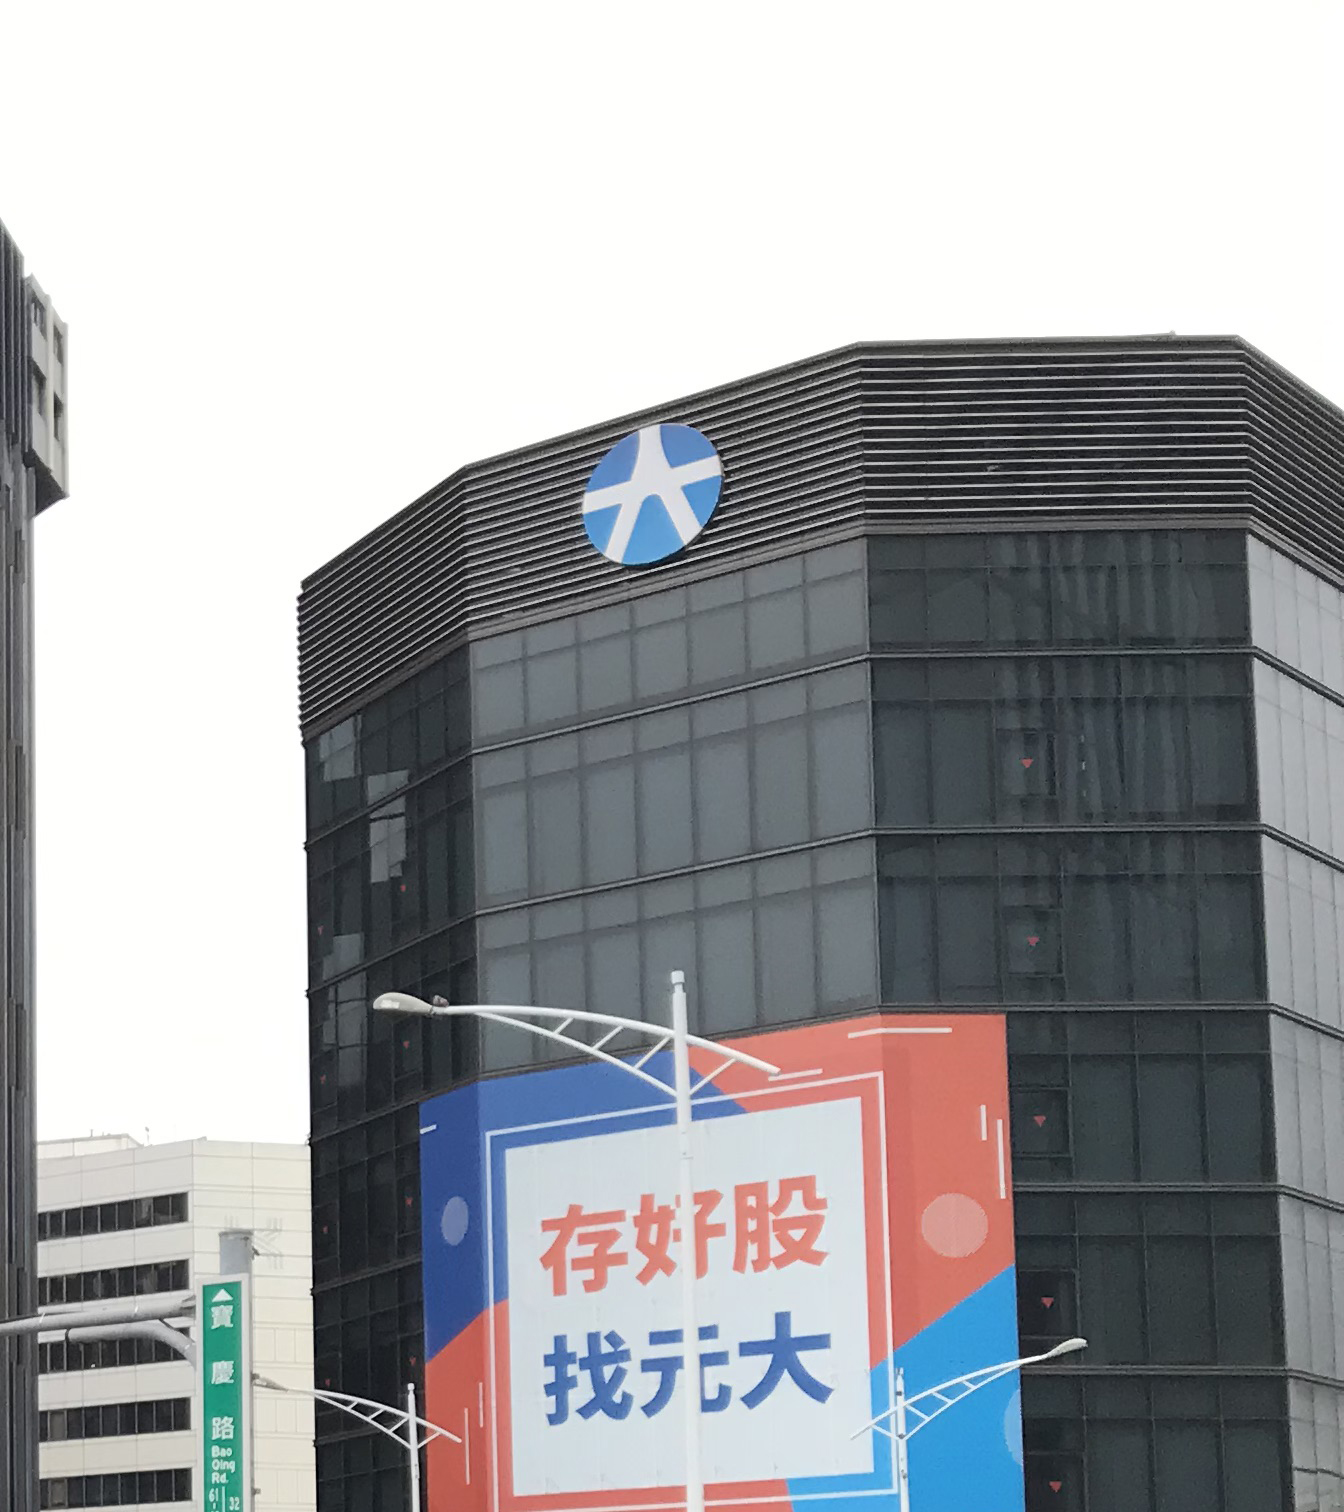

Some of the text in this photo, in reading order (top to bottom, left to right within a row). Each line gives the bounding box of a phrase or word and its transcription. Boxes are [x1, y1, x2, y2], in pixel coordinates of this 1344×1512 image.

[539, 1174, 828, 1297] 存好股
[210, 1304, 235, 1441] 寶慶路
[543, 1311, 834, 1426] 找元大
[212, 1445, 232, 1458] Bao
[212, 1459, 236, 1474] Qing
[212, 1472, 229, 1484] Rd.
